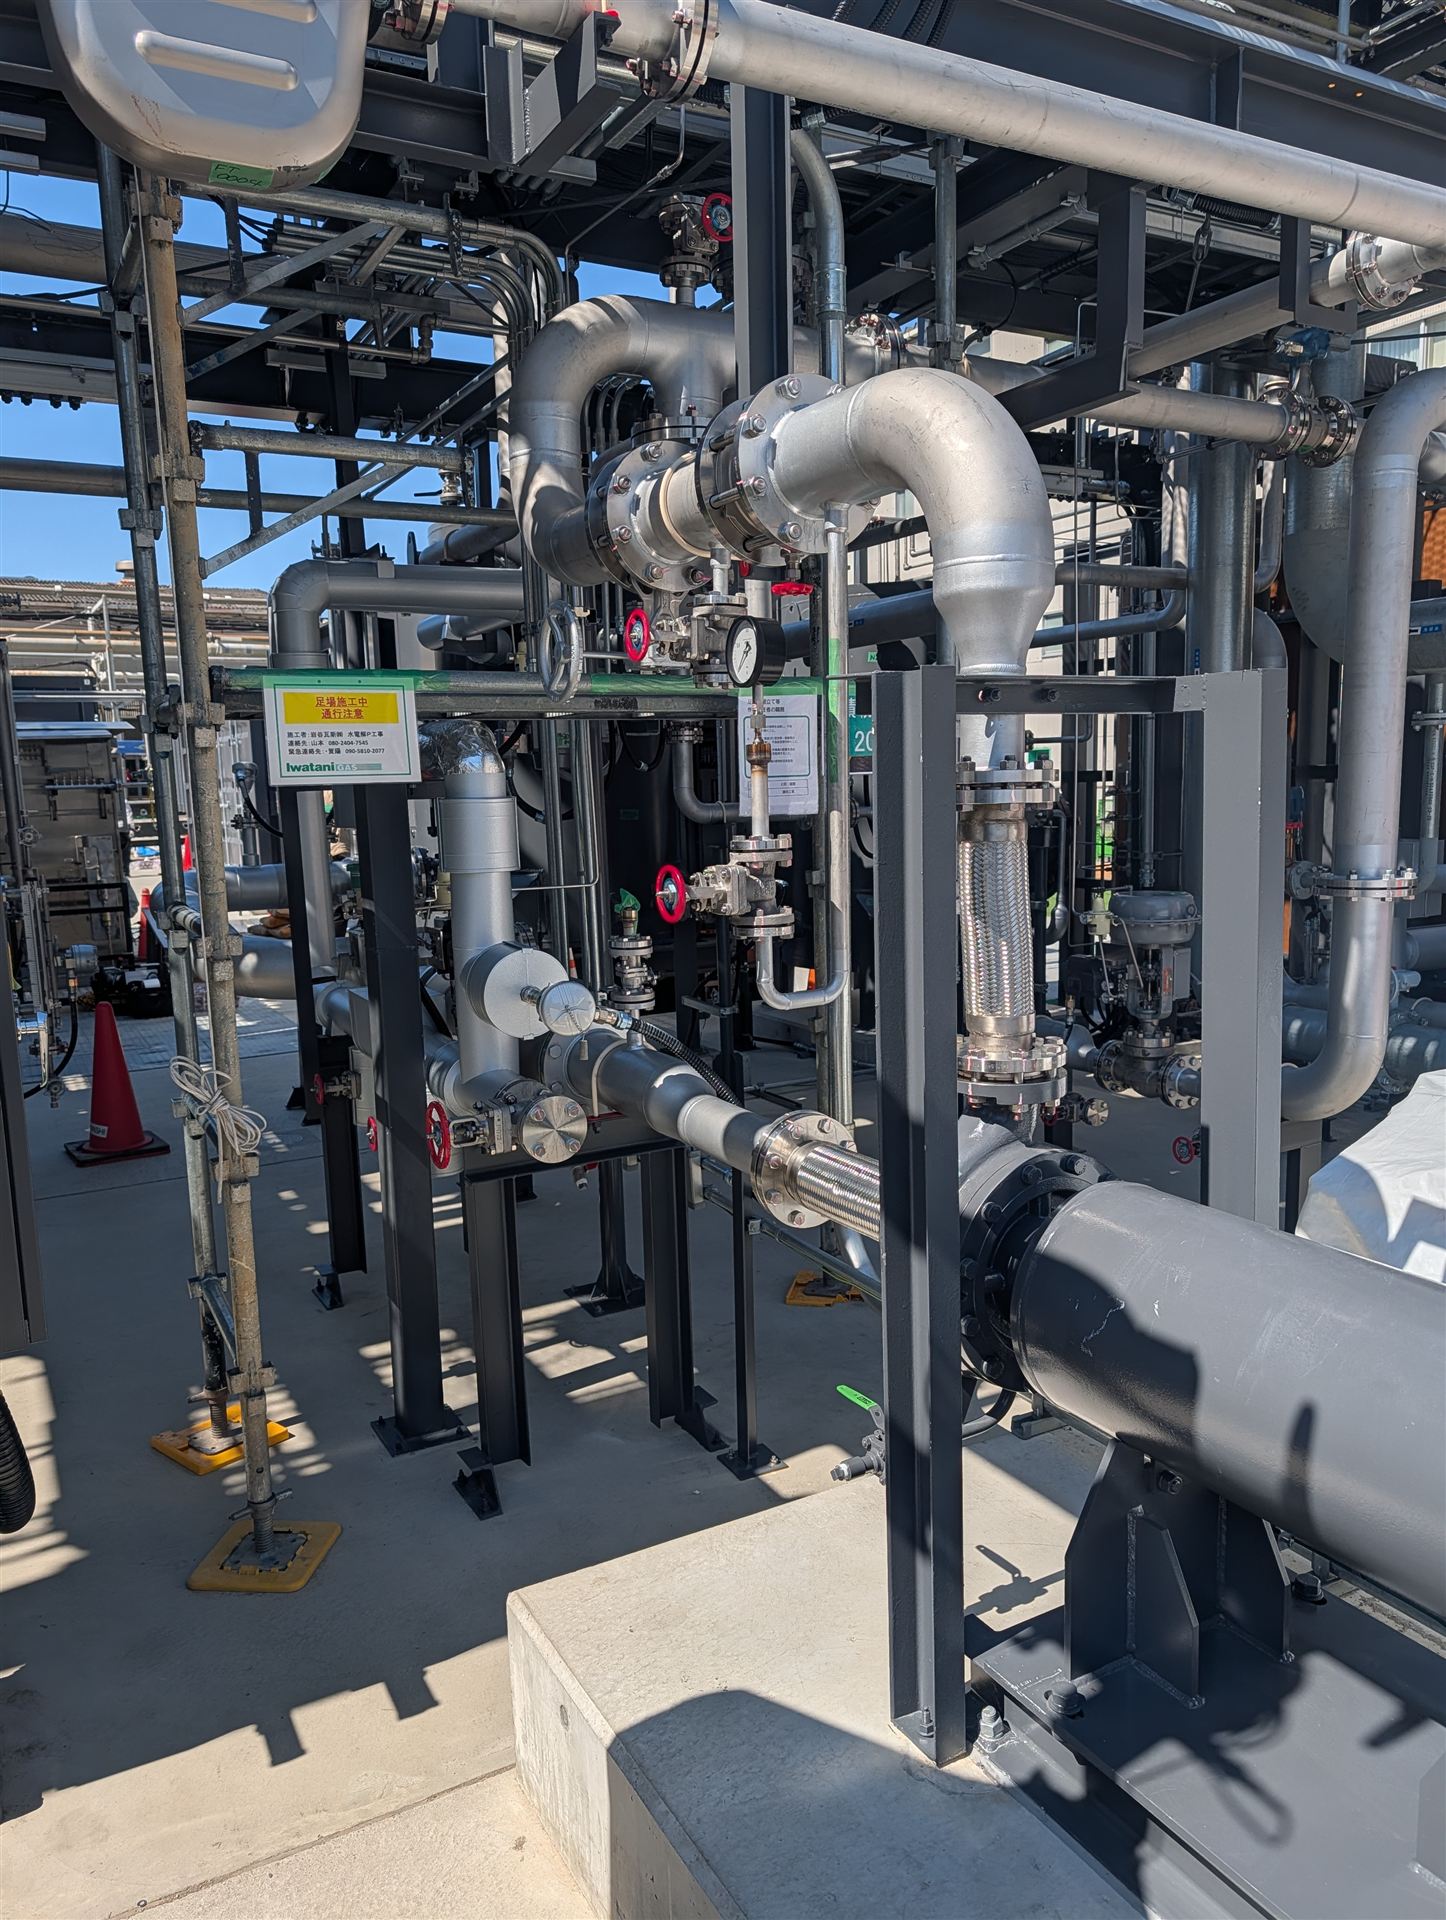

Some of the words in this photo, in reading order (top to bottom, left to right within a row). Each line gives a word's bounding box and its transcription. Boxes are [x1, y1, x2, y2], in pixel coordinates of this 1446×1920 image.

[315, 696, 368, 707] 足場施工中
[321, 708, 364, 719] 通行注意
[286, 762, 335, 772] Iwatani
[336, 763, 358, 771] GAS
